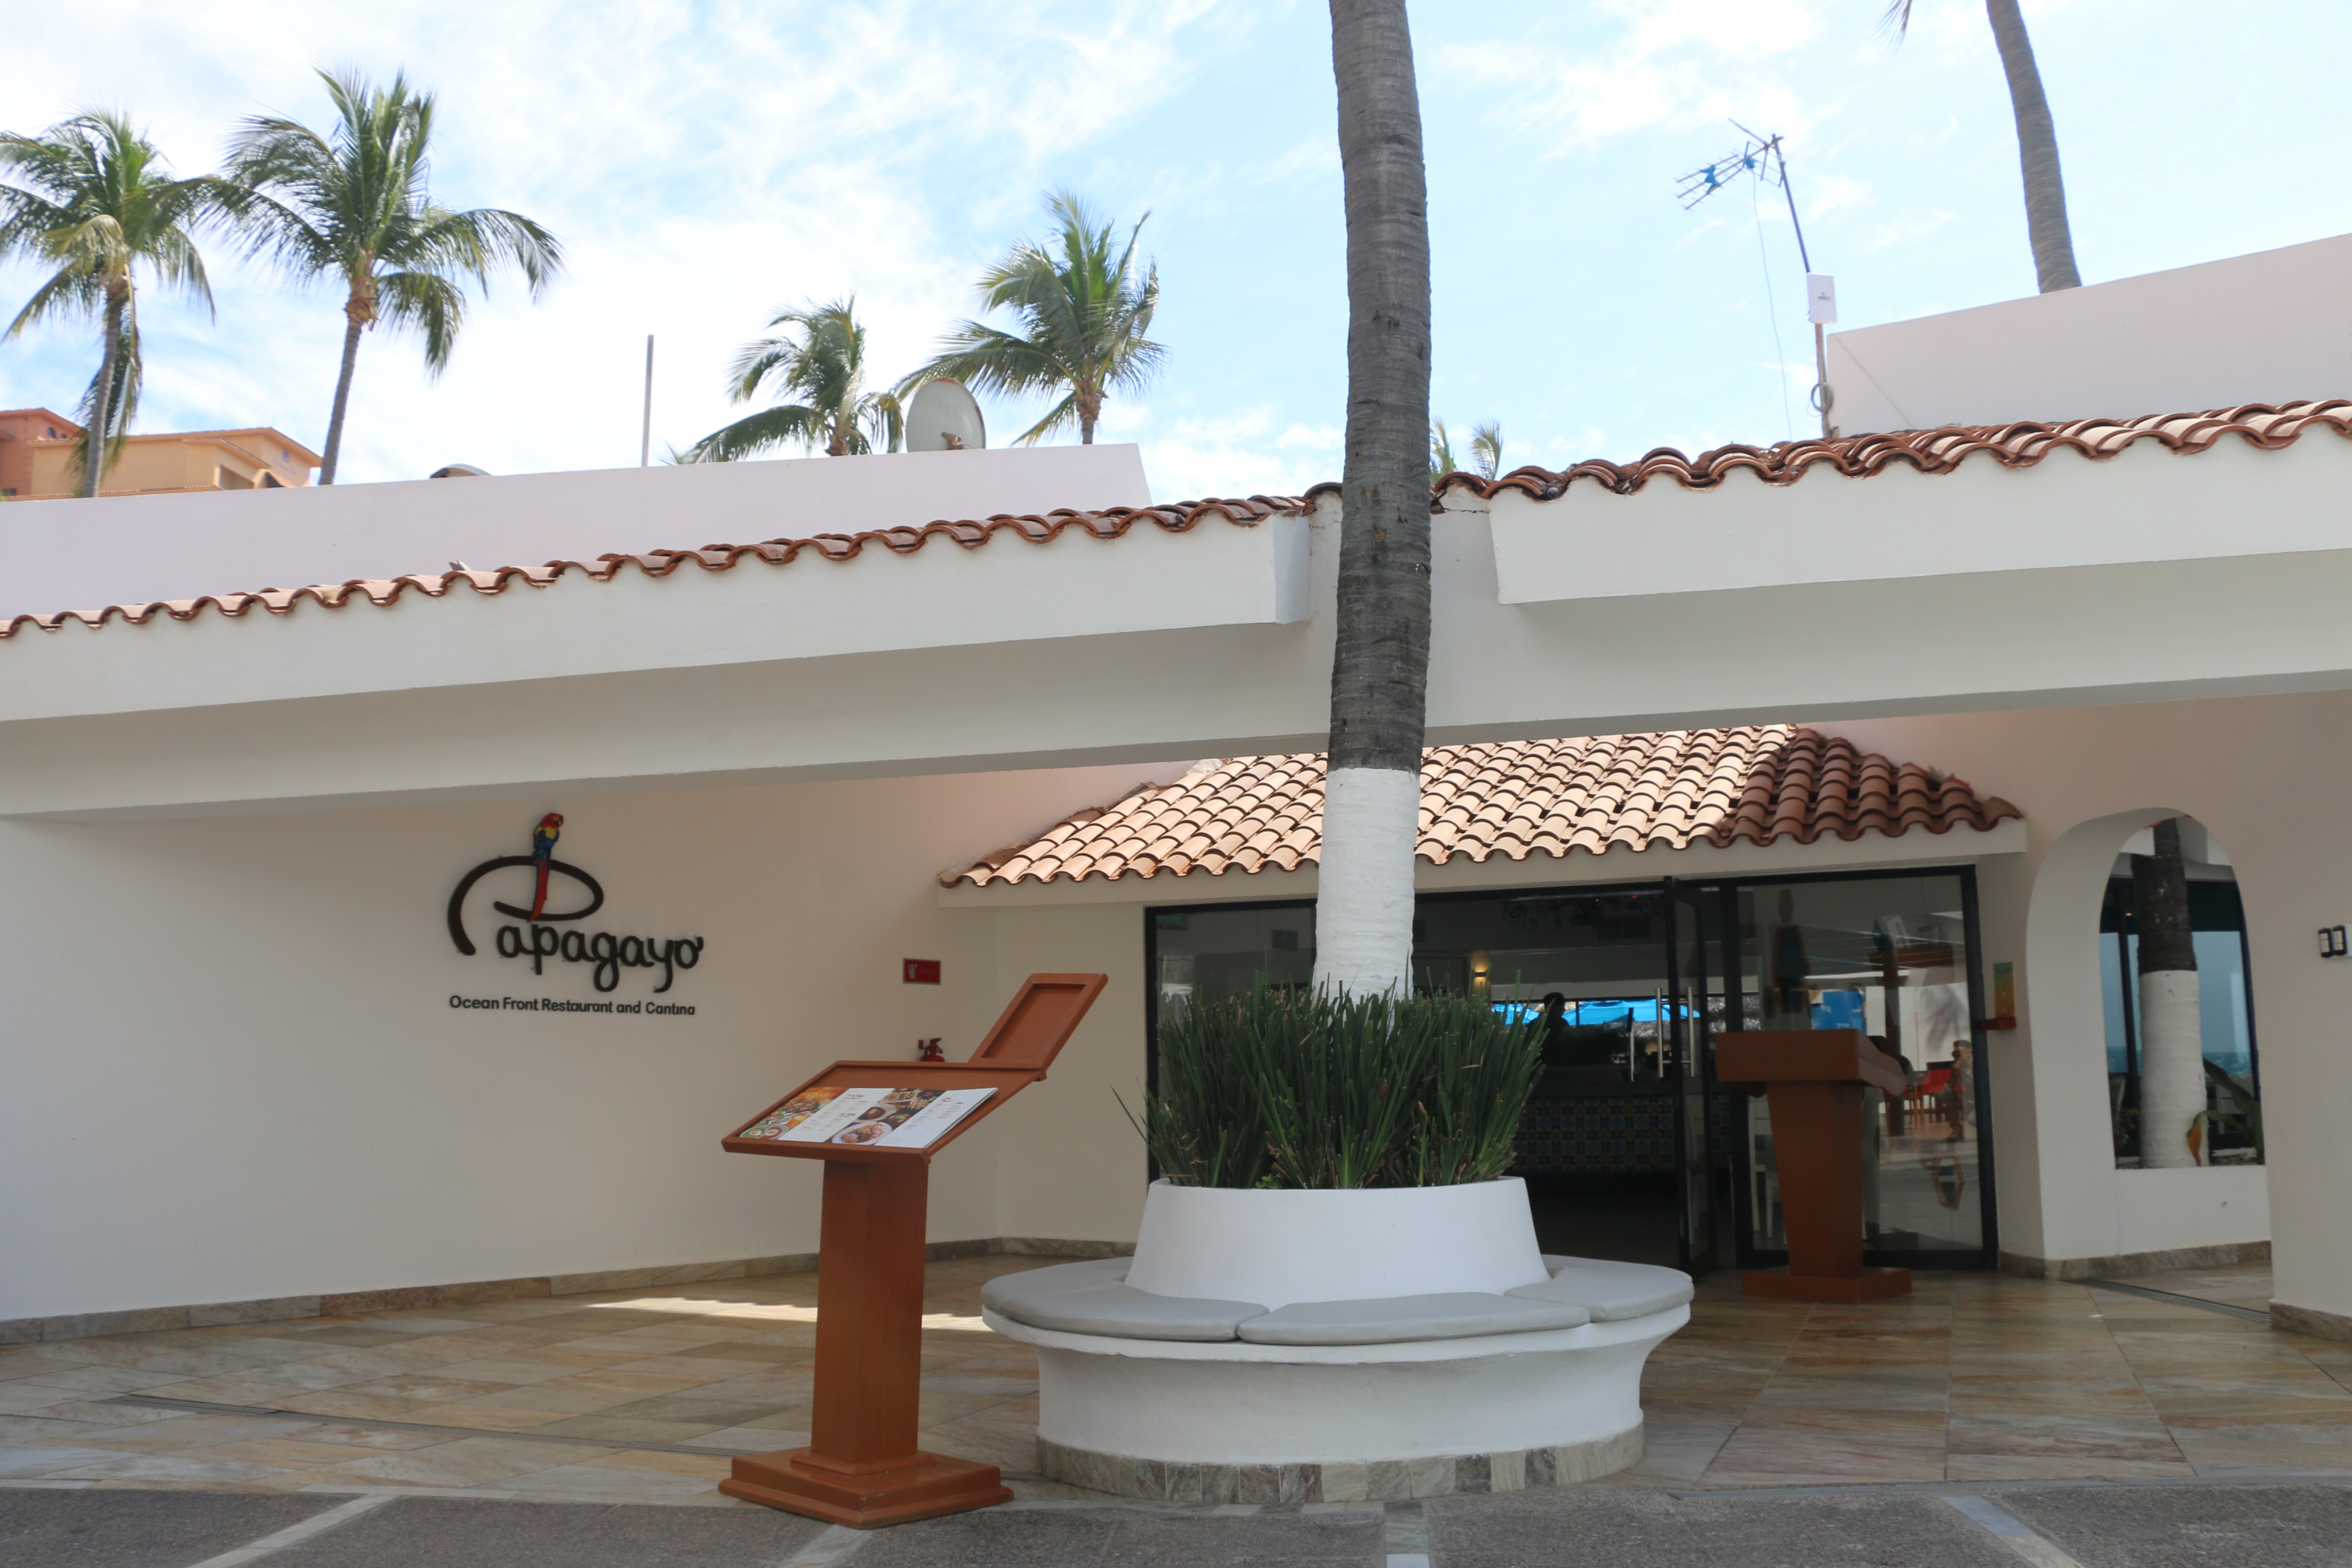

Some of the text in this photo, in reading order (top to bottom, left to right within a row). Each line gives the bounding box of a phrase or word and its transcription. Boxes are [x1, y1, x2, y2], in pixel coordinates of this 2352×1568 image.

[447, 856, 704, 993] Papagayo
[449, 995, 695, 1015] Ocean Front Restaurant and Cantina
